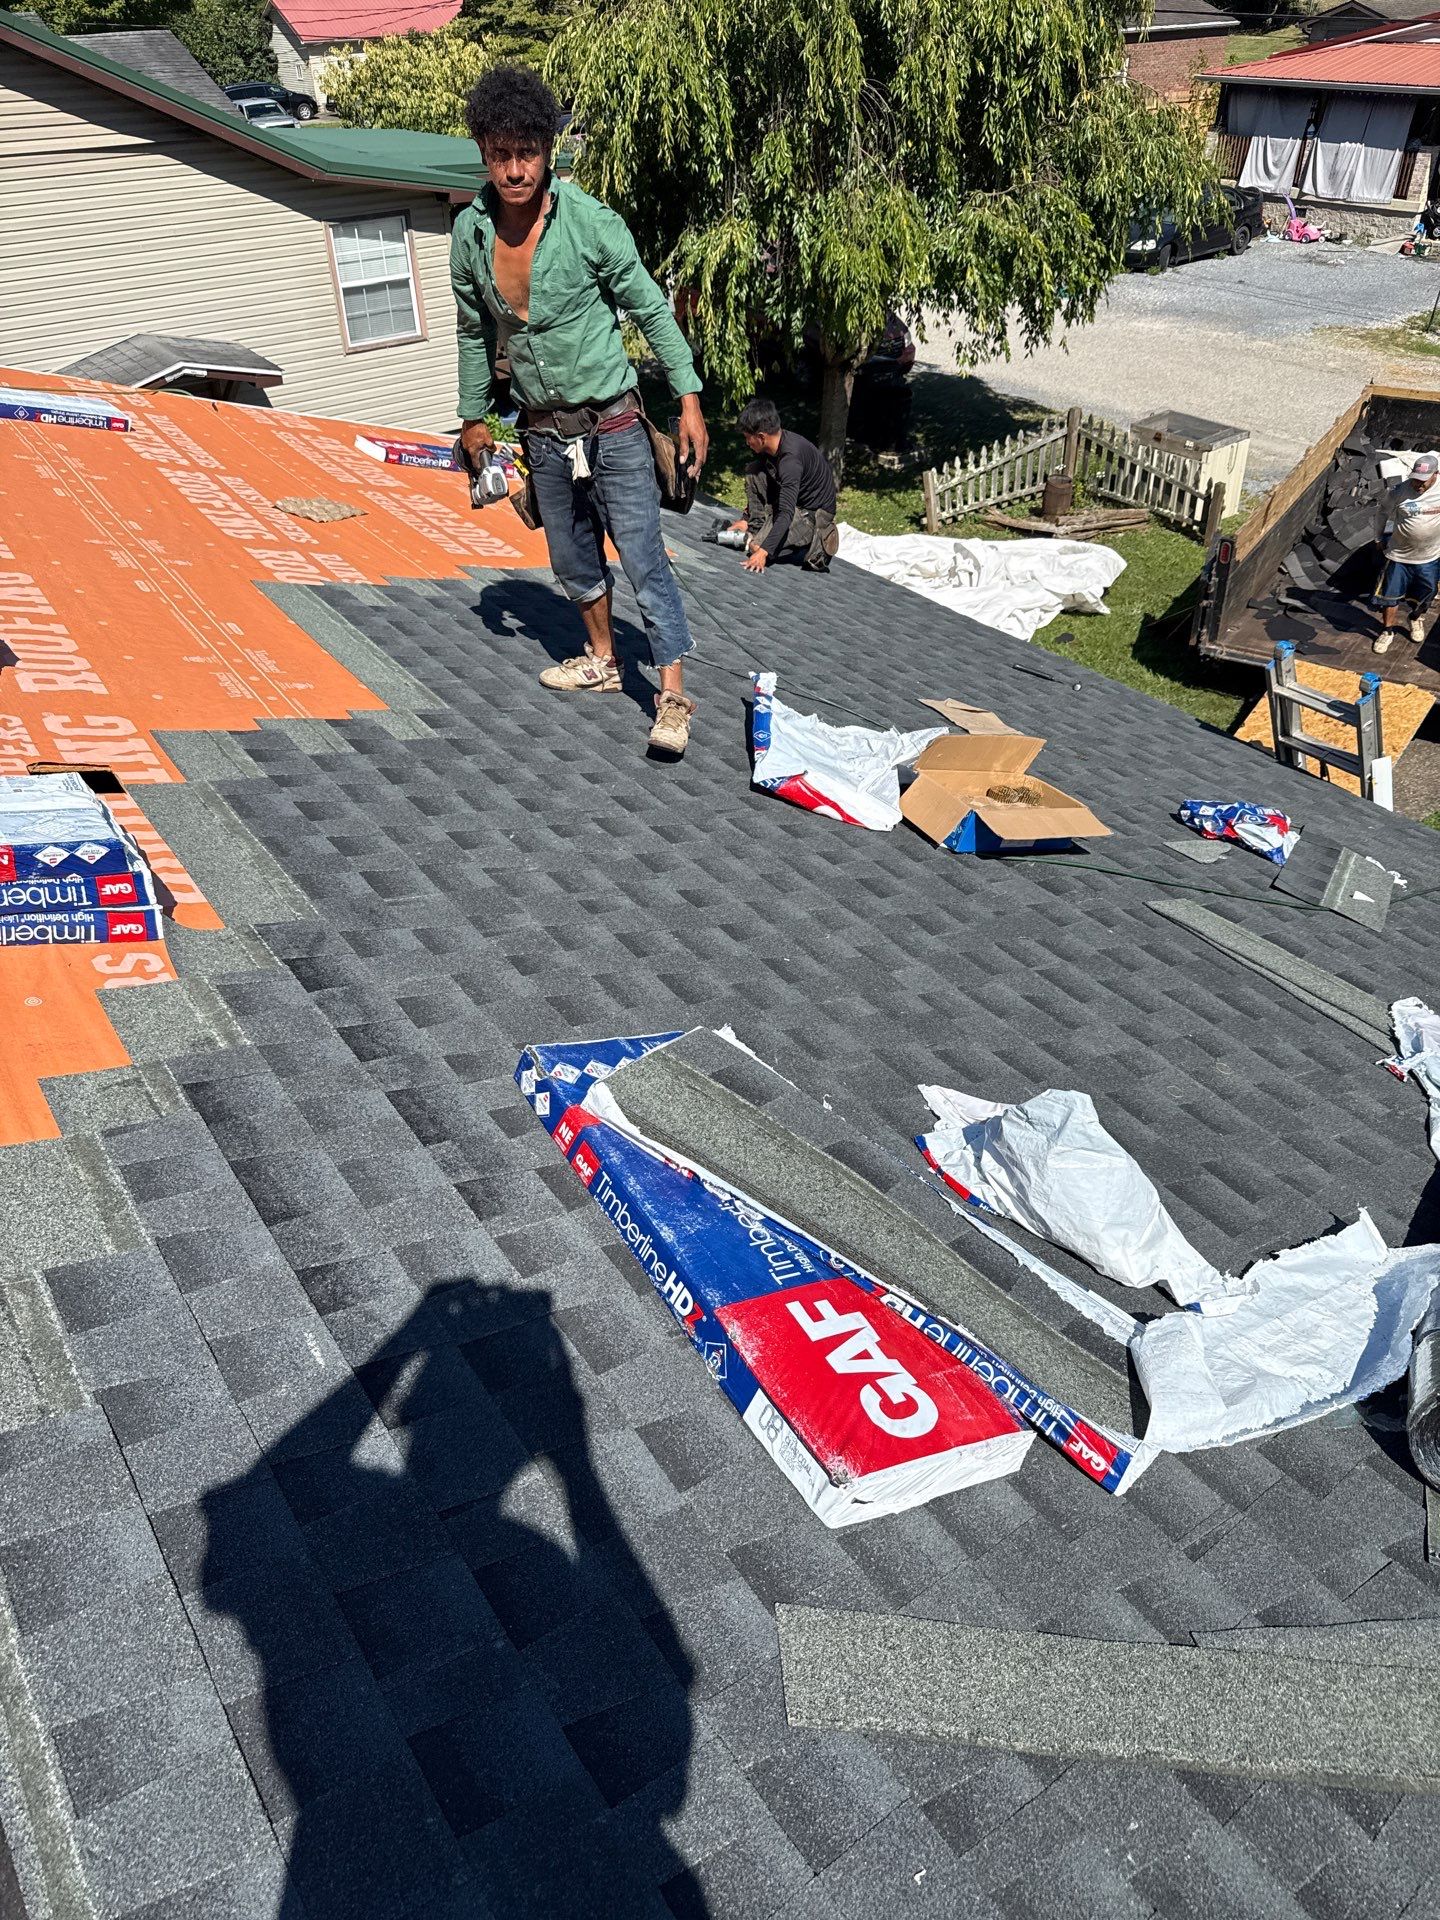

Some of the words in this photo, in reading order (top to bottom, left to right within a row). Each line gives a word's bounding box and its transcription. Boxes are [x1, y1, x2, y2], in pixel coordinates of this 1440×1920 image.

[155, 467, 280, 543] ROOFING
[0, 885, 93, 908] Timber
[101, 882, 133, 896] GAF
[110, 923, 144, 935] GAF
[556, 1121, 575, 1146] NE
[574, 1153, 594, 1180] GAF
[785, 1299, 940, 1439] GAF
[1069, 1439, 1107, 1473] GAF
